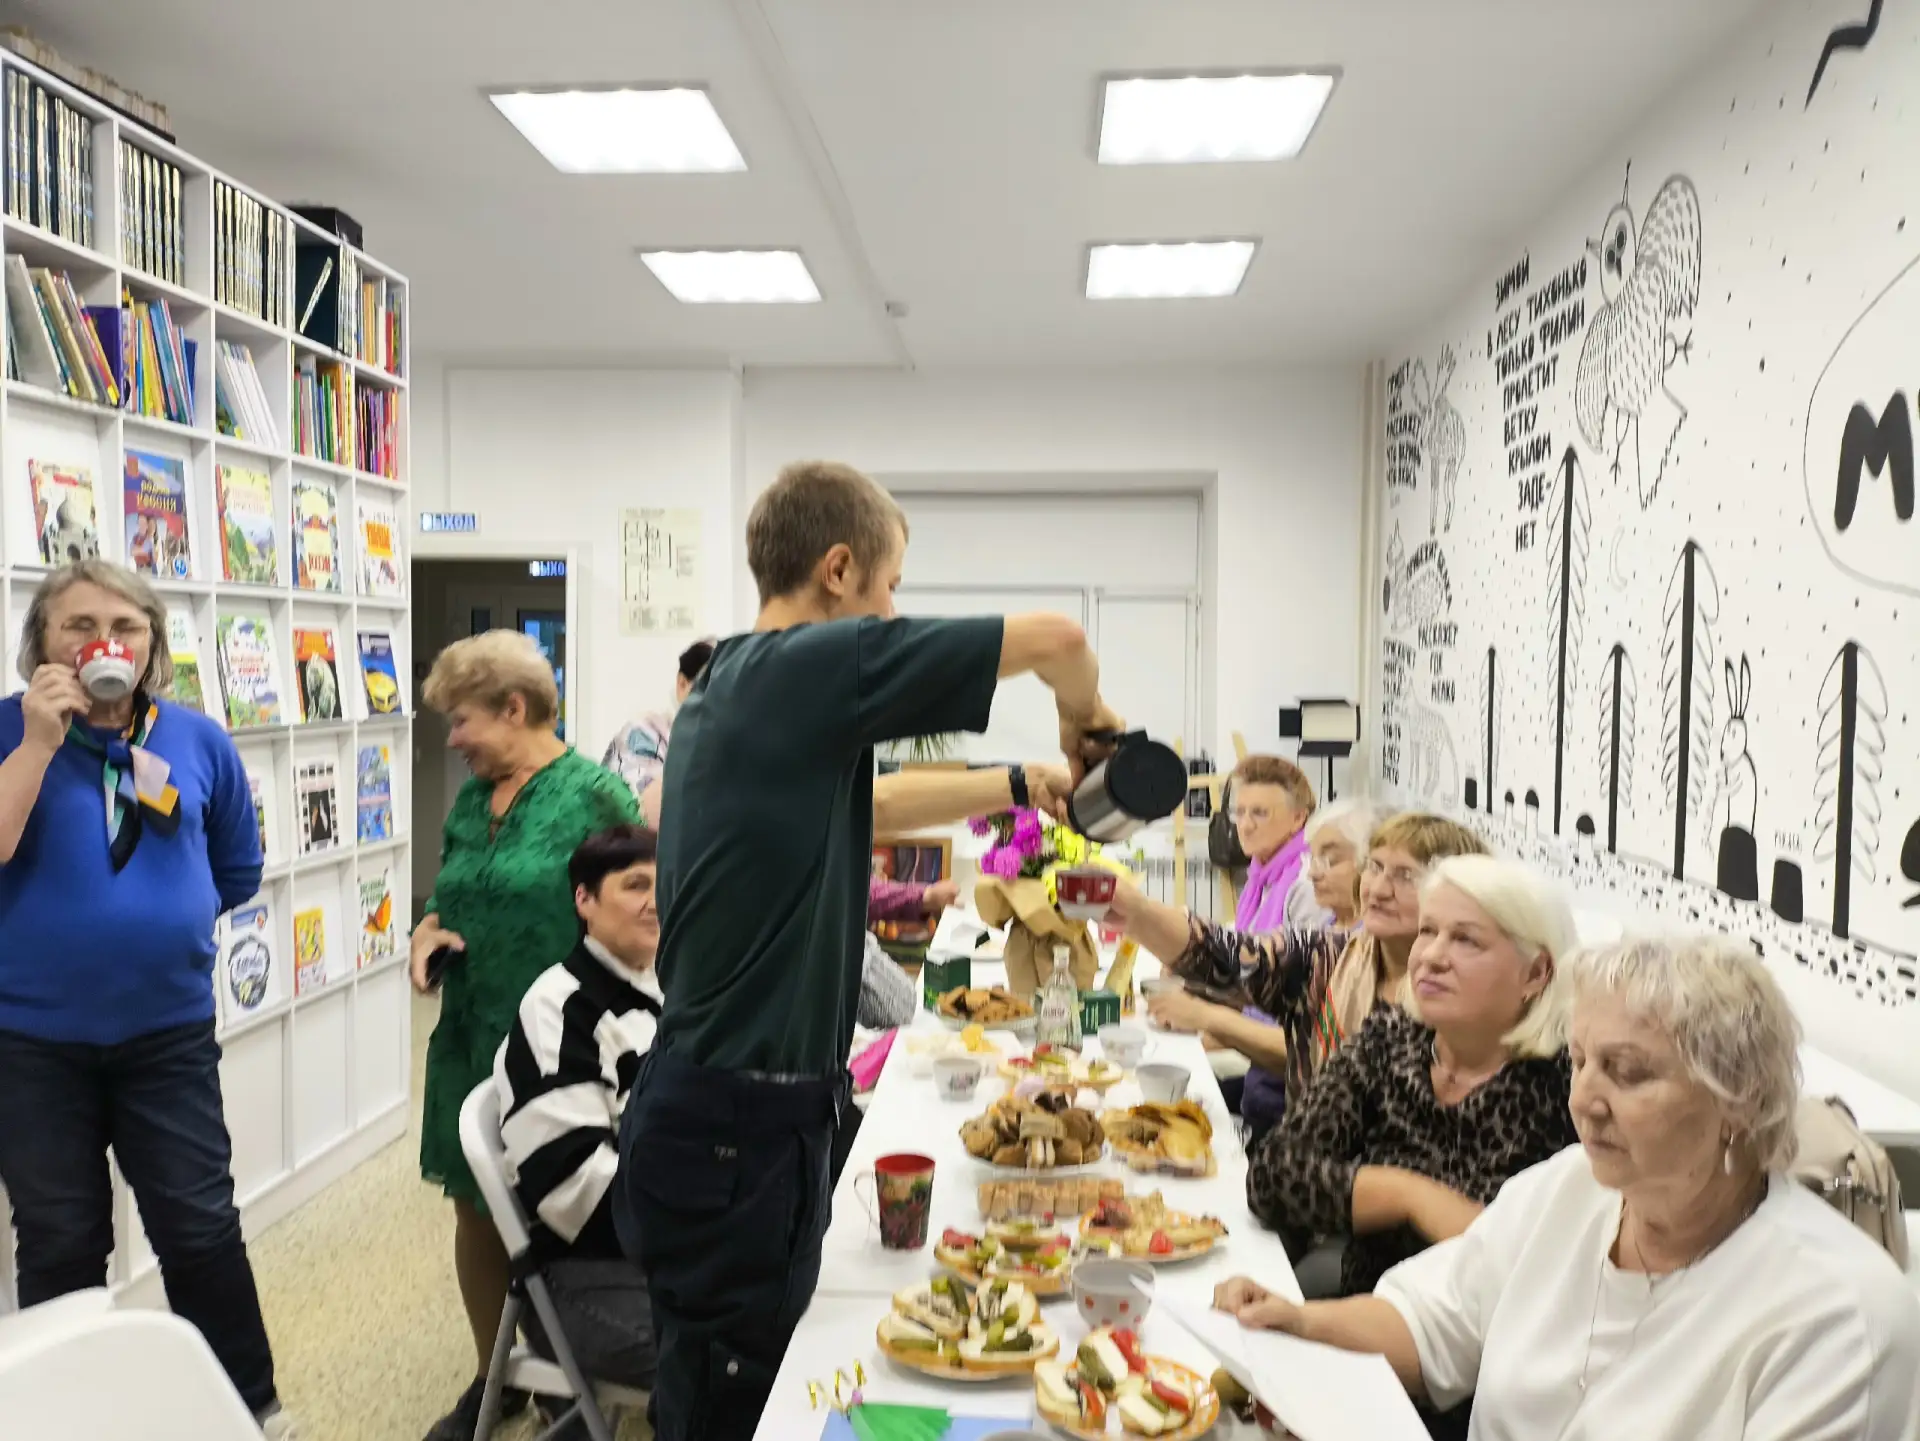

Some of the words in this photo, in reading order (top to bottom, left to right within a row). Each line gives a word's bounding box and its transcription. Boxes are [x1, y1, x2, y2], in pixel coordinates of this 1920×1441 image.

[1486, 328, 1493, 360] В
[1496, 304, 1521, 353] ЛЕСУ
[1526, 255, 1587, 327] ТИХОНЬКО
[1495, 248, 1529, 313] ЗИМОЙ
[1494, 331, 1535, 386] ТОЛЬКО
[1539, 297, 1585, 355] ФИЛИН
[1503, 353, 1559, 414] ПРОЛЕТИТ
[1504, 403, 1538, 448] ВЕТКУ
[1508, 431, 1551, 478] КРЫЛОМ
[1834, 387, 1920, 532] М
[1515, 519, 1537, 553] НЕТ
[532, 561, 566, 577] ВЫХО
